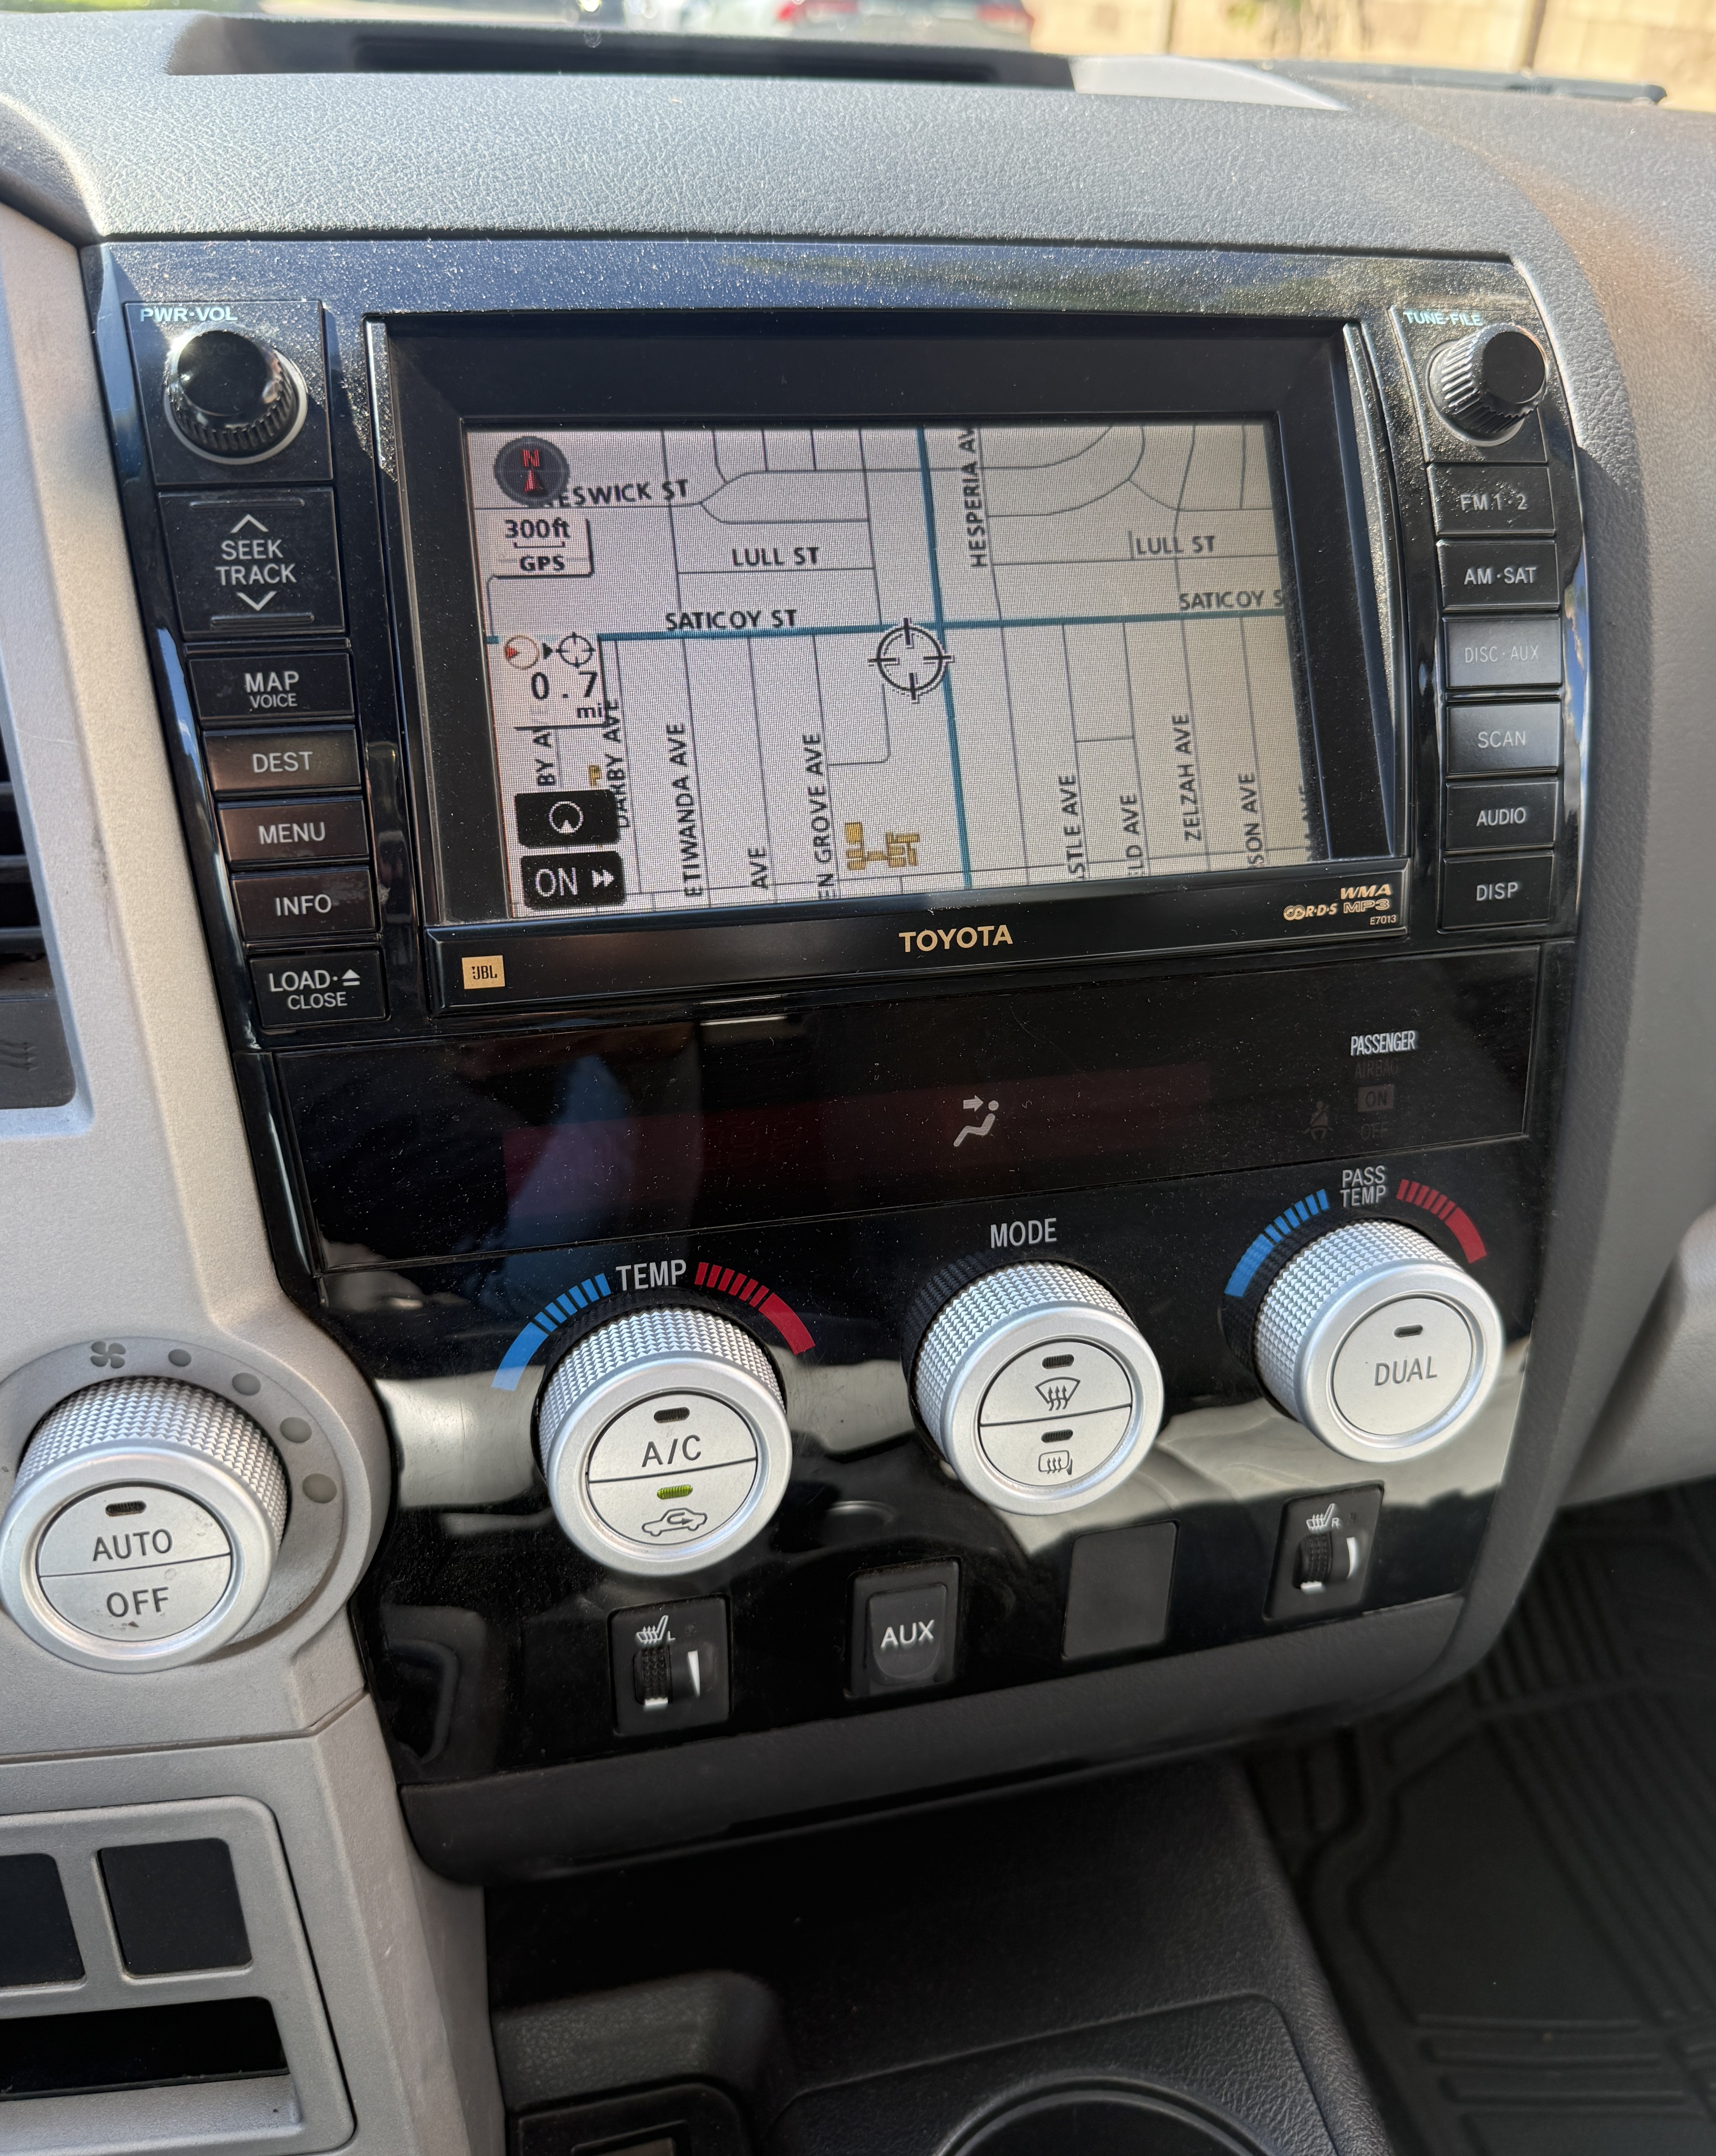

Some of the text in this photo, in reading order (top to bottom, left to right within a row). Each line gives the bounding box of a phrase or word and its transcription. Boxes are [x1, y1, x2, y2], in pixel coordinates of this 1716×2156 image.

[544, 479, 688, 507] ESWICK ST
[1460, 494, 1487, 511] FM
[961, 461, 987, 568] HESPERIA
[505, 517, 570, 538] 300ft
[220, 539, 284, 560] SEEK
[732, 547, 819, 566] LULL ST
[1136, 536, 1215, 555] LULL ST
[215, 563, 297, 586] TRACK
[520, 556, 565, 571] GPS
[1179, 590, 1264, 610] SATICOY
[666, 609, 797, 631] SATICOY ST
[245, 671, 299, 693] MAP
[532, 672, 597, 699] 0.7
[250, 693, 298, 708] VOICE
[578, 703, 603, 717] mi
[533, 728, 552, 748] A
[1477, 731, 1526, 749] SCAN
[252, 751, 313, 773] DEST
[803, 734, 824, 775] AVE
[1172, 715, 1200, 841] ZELZAH AVE
[1239, 774, 1256, 813] AVE
[667, 723, 702, 896] ETIWANDA AVE
[1120, 795, 1139, 835] AVE
[1476, 807, 1527, 827] AUDIO
[258, 823, 326, 845] MENU
[808, 787, 832, 863] GROVE
[1058, 776, 1086, 879] STLE AVE
[748, 847, 768, 889] AVE
[535, 868, 578, 897] ON
[1341, 884, 1391, 899] WMA
[1476, 883, 1519, 902] DISP
[275, 894, 332, 916] INFO
[1343, 899, 1390, 914] MP3
[1370, 915, 1396, 925] E7013
[899, 925, 1013, 952] TOYOTA
[471, 965, 497, 980] JBL
[288, 992, 348, 1010] CLOSE
[1351, 1030, 1417, 1056] PASSENGER
[1365, 1091, 1387, 1108] ON
[1342, 1166, 1386, 1188] PASS
[1340, 1185, 1387, 1207] TEMP
[990, 1218, 1058, 1248] MODE
[616, 1260, 687, 1290] TEMP
[1374, 1356, 1437, 1385] DUAL
[641, 1434, 701, 1467] A/C
[92, 1529, 173, 1562] AUTO
[107, 1587, 170, 1617] OFF
[880, 1619, 934, 1650] AUX
